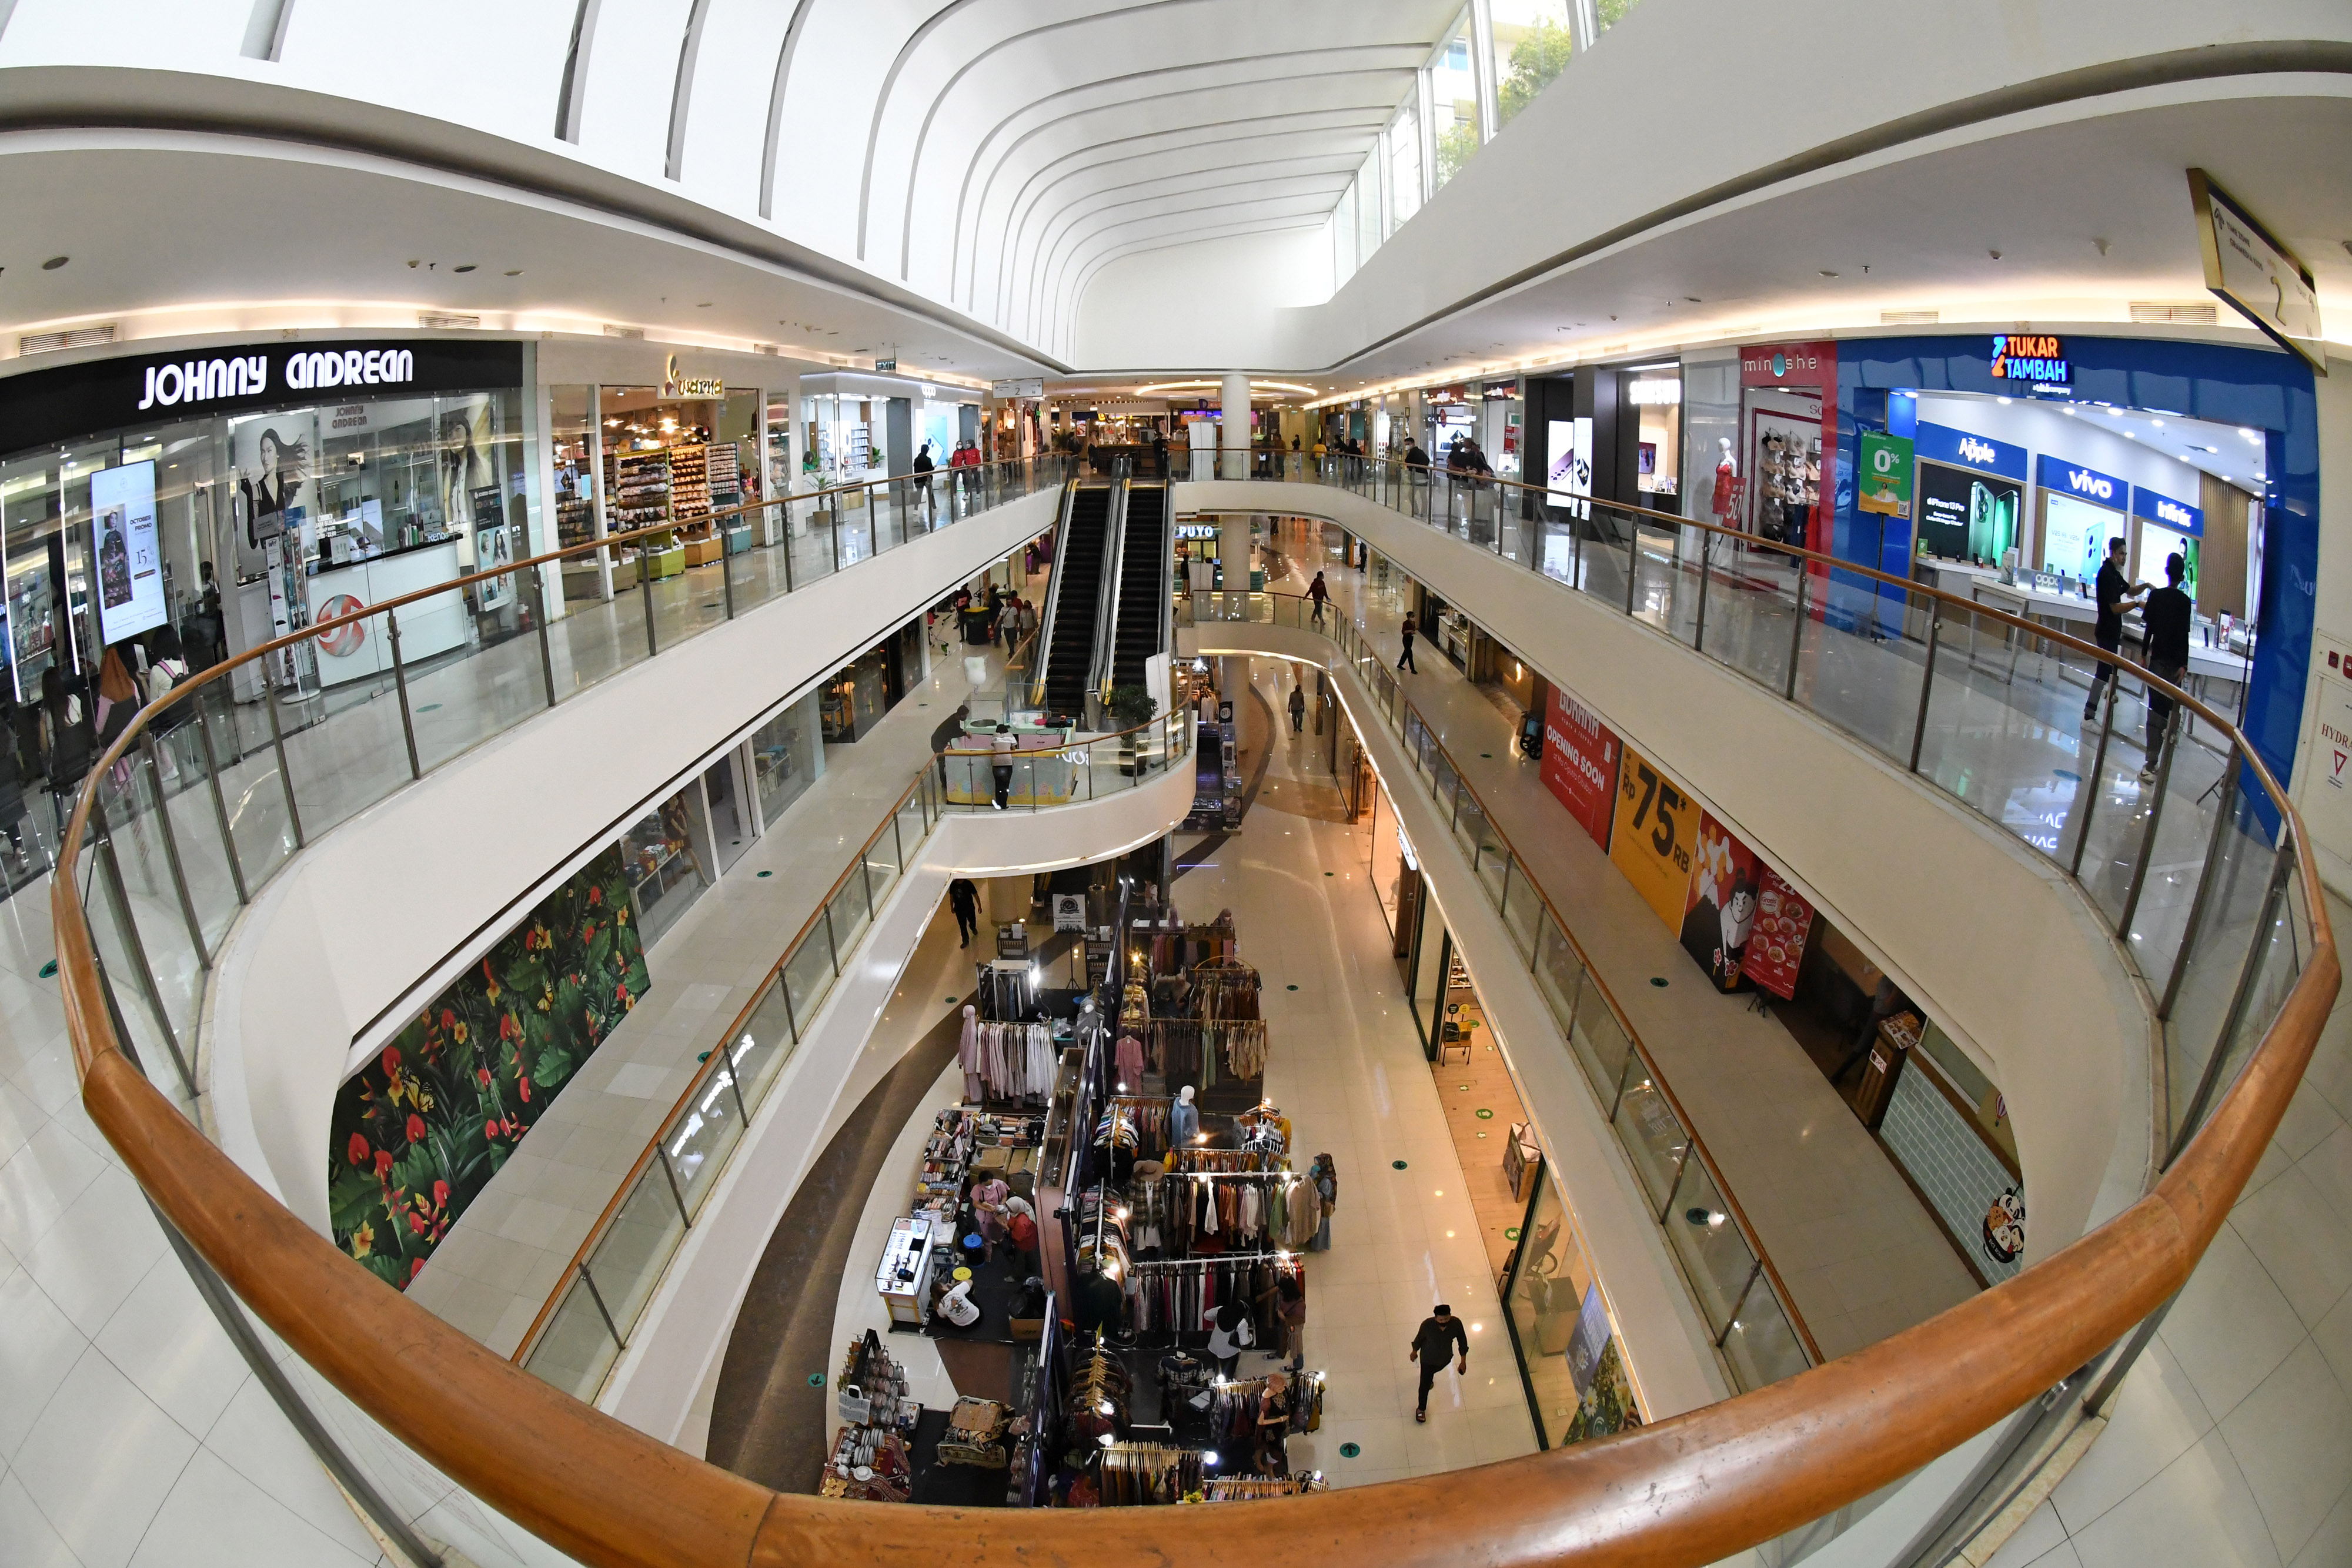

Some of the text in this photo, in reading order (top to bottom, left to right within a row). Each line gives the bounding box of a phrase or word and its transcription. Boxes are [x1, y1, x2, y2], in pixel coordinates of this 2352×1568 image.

[2007, 336, 2058, 357] TUKAR
[876, 361, 895, 370] EXIT
[1744, 353, 1817, 377] minoshe
[2004, 358, 2067, 382] TAMBAH
[1015, 387, 1021, 396] 2
[1959, 437, 1996, 463] Apple
[1873, 450, 1900, 473] 0%
[2069, 469, 2112, 499] vivo
[1931, 498, 1965, 511] iPhone 13 Pro
[130, 515, 152, 524] OCTOBER
[135, 523, 152, 531] PROMO
[1178, 526, 1214, 537] PUYO
[1547, 724, 1579, 767] OPENING
[1580, 755, 1605, 792] SOON
[1623, 773, 1635, 801] Rp
[1673, 843, 1690, 874] RB
